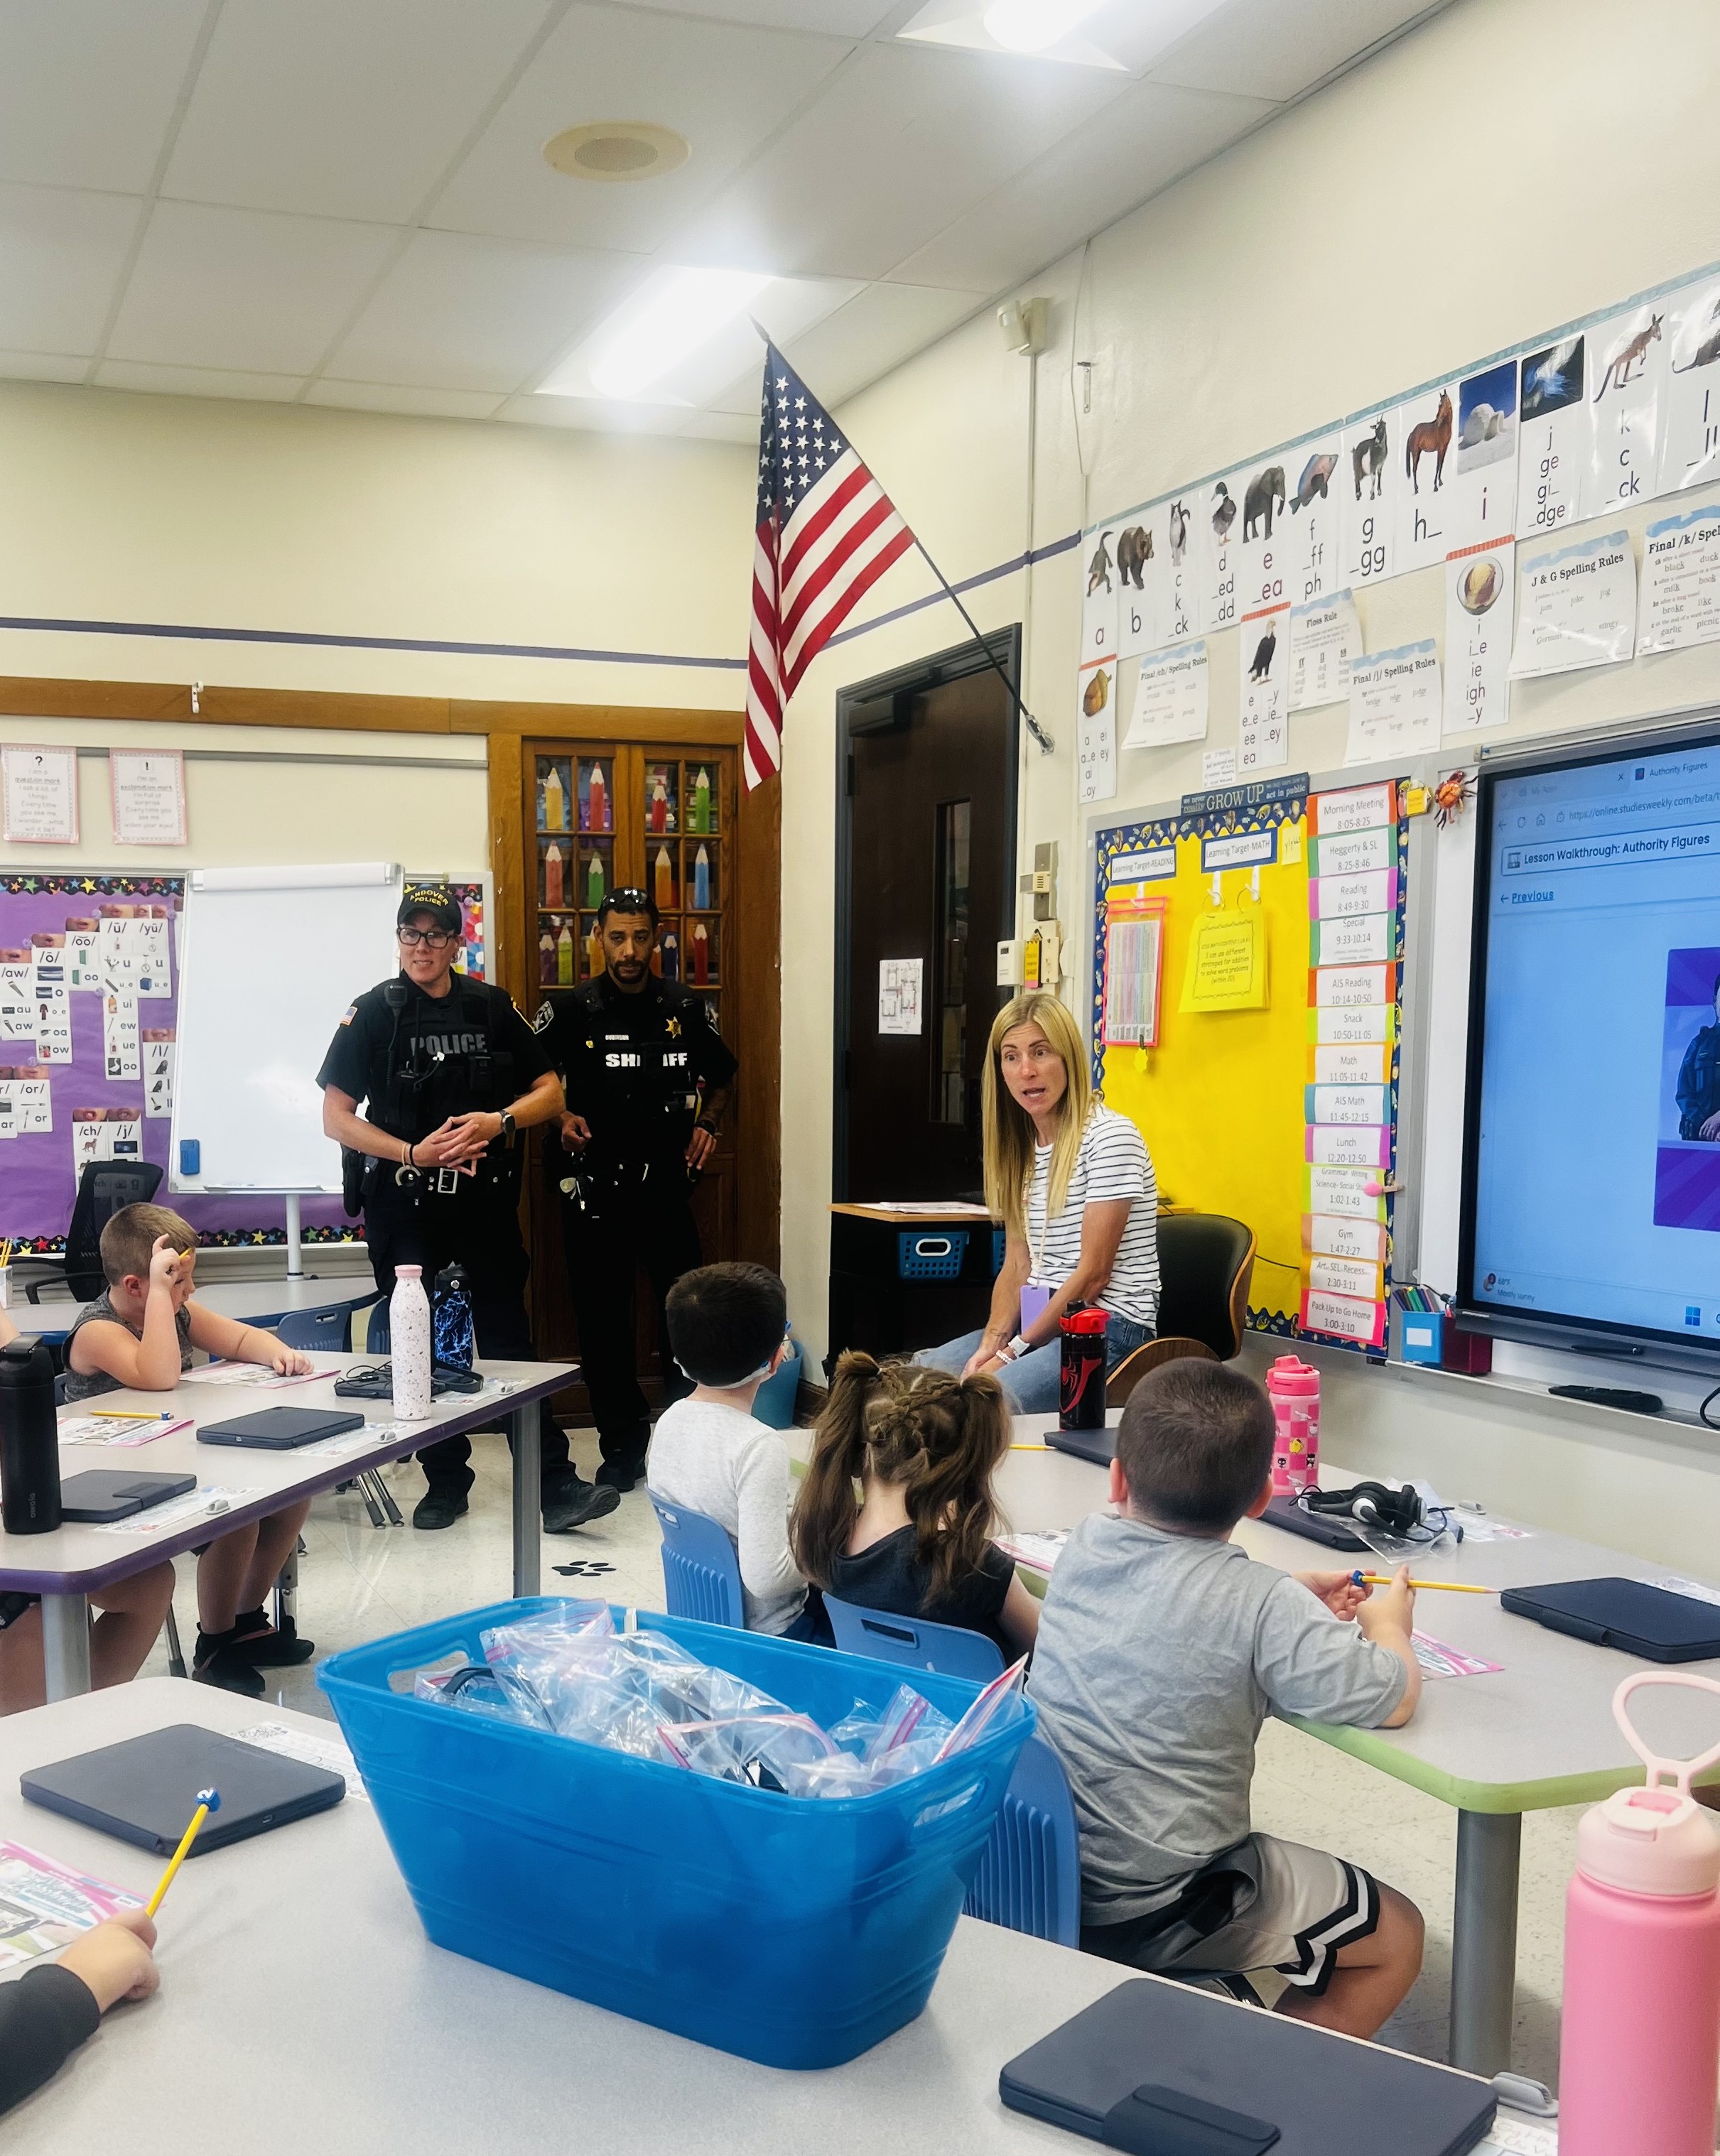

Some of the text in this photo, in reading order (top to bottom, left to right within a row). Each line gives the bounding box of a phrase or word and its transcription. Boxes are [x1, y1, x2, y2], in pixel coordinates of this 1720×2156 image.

[1621, 409, 1630, 435] k
[1547, 426, 1552, 451] j
[1620, 449, 1630, 466] c
[1540, 455, 1559, 478] ge
[1483, 487, 1487, 520] i
[1310, 519, 1315, 541] f
[1363, 517, 1373, 544] g
[1648, 537, 1675, 554] Final
[1677, 531, 1697, 548] /k/
[1218, 550, 1226, 571] d
[1263, 552, 1272, 570] e
[1699, 552, 1719, 563] duck
[1532, 553, 1624, 587] J & G Spelling Rules
[1176, 574, 1181, 586] c
[1304, 572, 1321, 601] ph
[1175, 593, 1181, 611] k
[1131, 607, 1142, 634] b
[1307, 611, 1337, 629] Floss Rule
[1096, 627, 1104, 645] a
[1140, 667, 1156, 681] Final
[1168, 660, 1191, 676] Spelling
[1192, 656, 1207, 666] Rules
[1353, 672, 1371, 686] Final
[1384, 663, 1414, 678] Spelling
[1415, 658, 1436, 669] Rules
[1471, 662, 1482, 678] ie
[1466, 681, 1486, 705] igh
[1249, 695, 1254, 707] e
[1084, 736, 1090, 746] a
[1100, 727, 1108, 741] ei
[1244, 732, 1255, 745] ee
[1100, 747, 1109, 762] ey
[1243, 751, 1256, 764] ea
[1086, 765, 1093, 780] ai
[1649, 762, 1708, 777] Authority Figures
[1206, 784, 1265, 811] GROW UP
[1265, 784, 1306, 800] act in public
[1324, 797, 1385, 816] Morning Meeting
[1206, 846, 1231, 859] Learning
[1231, 840, 1270, 855] Target-MATH
[1329, 840, 1378, 856] Heggerty & SL
[1524, 834, 1710, 865] Lesson Walkthrough: Authority Figures
[1112, 856, 1174, 874] Learning Target-READING
[1337, 858, 1370, 871] 8:25-8:46
[410, 889, 449, 906] ANDOVER
[1341, 884, 1368, 897] Reading
[1512, 890, 1554, 904] Previous
[414, 896, 442, 906] POLICE
[1337, 900, 1369, 913] 8:49-9:30
[1343, 916, 1365, 929] Special
[1336, 933, 1370, 945] 9:33-10:14
[123, 959, 131, 968] u
[156, 959, 163, 968] u
[1, 967, 29, 978] /aw/
[1332, 977, 1372, 989] AIS Reading
[122, 1000, 132, 1009] ui
[1331, 993, 1372, 1004] 10:14-10:50
[1343, 1013, 1363, 1023] Snack
[409, 1033, 487, 1056] POLICE
[605, 1053, 688, 1067] SHIFF
[1340, 1056, 1358, 1066] Math
[20, 1083, 45, 1094] /or/
[1334, 1096, 1365, 1105] AIS Math
[1330, 1112, 1370, 1122] 11:45-12:15
[79, 1125, 102, 1137] /ch/
[117, 1124, 133, 1139] /j/
[1336, 1137, 1356, 1147] Lunch
[1327, 1153, 1367, 1164] 12:20-12:50
[1351, 1170, 1368, 1180] Writing
[1339, 1181, 1355, 1190] Social
[1338, 1228, 1353, 1240] Gym
[1330, 1244, 1361, 1257] 1:47-2:27
[1330, 1262, 1341, 1272] SEL
[1327, 1277, 1356, 1291] 2:30-3:11
[1311, 1301, 1371, 1321] Pack Up to Go Home
[1324, 1317, 1356, 1333] 3:00-3:10
